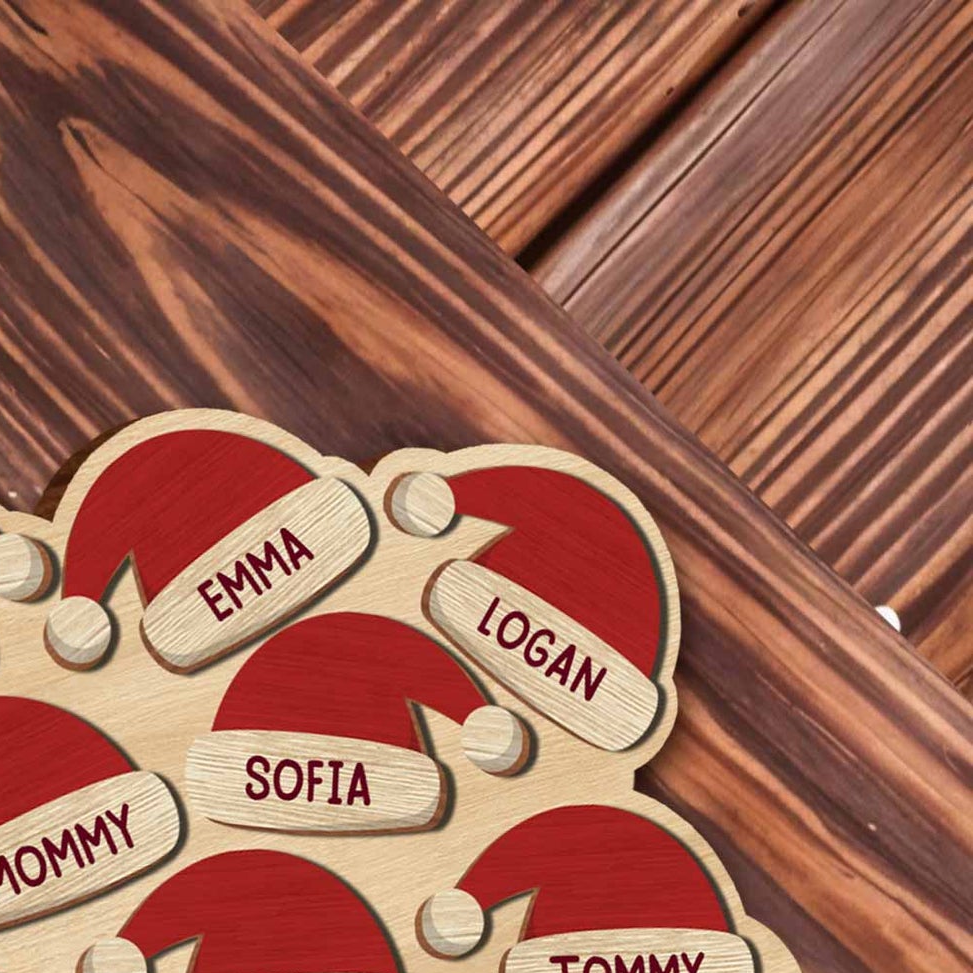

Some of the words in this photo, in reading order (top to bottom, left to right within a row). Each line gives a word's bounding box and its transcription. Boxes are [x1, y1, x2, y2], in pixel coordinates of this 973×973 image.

[196, 527, 315, 622] EMMA
[477, 596, 608, 702] LOGAN
[245, 755, 371, 806] SOFIA
